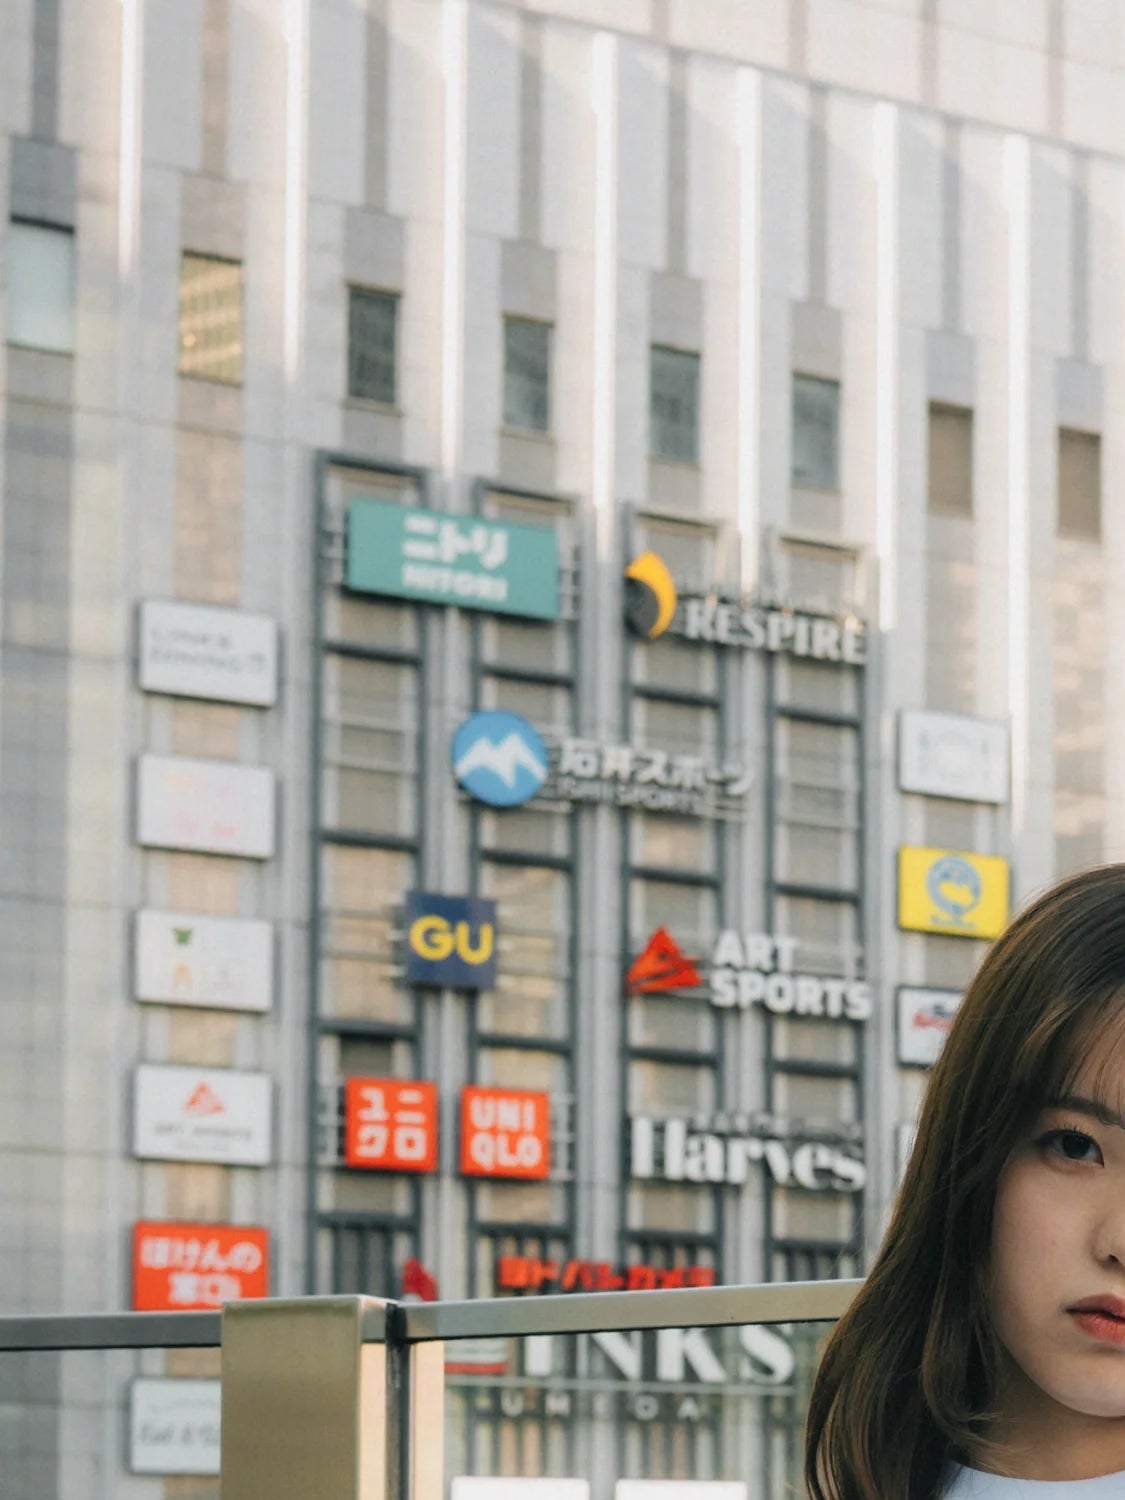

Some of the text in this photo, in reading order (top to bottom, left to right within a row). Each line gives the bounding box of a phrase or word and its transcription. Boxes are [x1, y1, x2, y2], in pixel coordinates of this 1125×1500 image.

[403, 514, 508, 570] ニトリ
[683, 598, 868, 665] RESPIRE
[560, 737, 755, 797] 石井スポーツ
[409, 915, 494, 966] GU
[712, 929, 797, 972] ART
[710, 968, 873, 1021] SPORTS
[357, 1088, 426, 1125] ユニ
[469, 1097, 536, 1133] UNI
[469, 1134, 542, 1169] QLO
[632, 1116, 867, 1194] Harves
